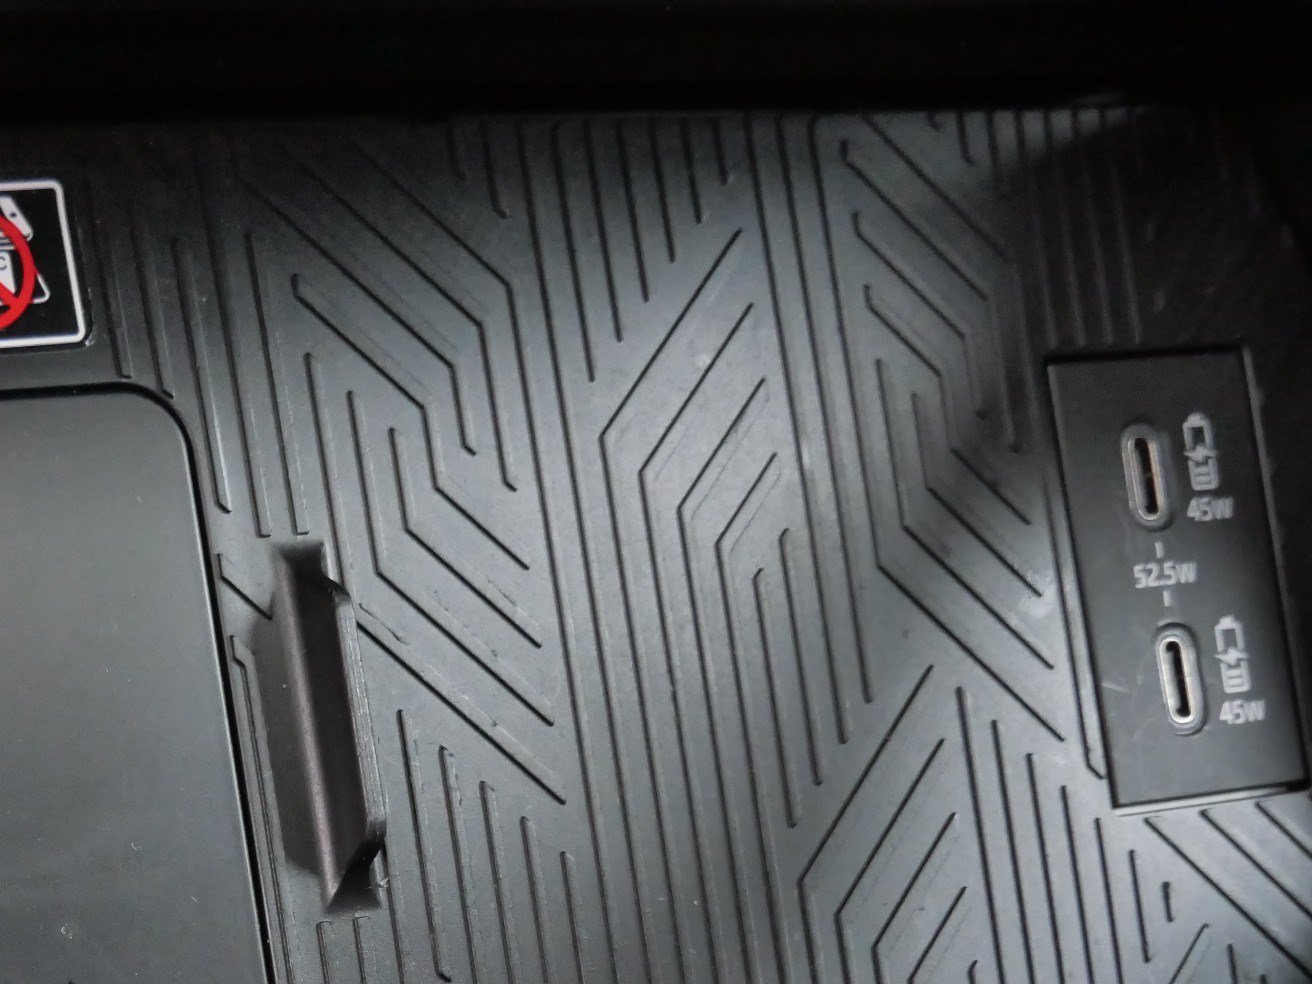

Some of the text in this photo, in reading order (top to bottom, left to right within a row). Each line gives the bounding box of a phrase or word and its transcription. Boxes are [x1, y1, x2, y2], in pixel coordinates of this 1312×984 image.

[1187, 496, 1234, 521] 45W
[1133, 561, 1197, 588] 52.5W
[1219, 699, 1266, 724] 45W
